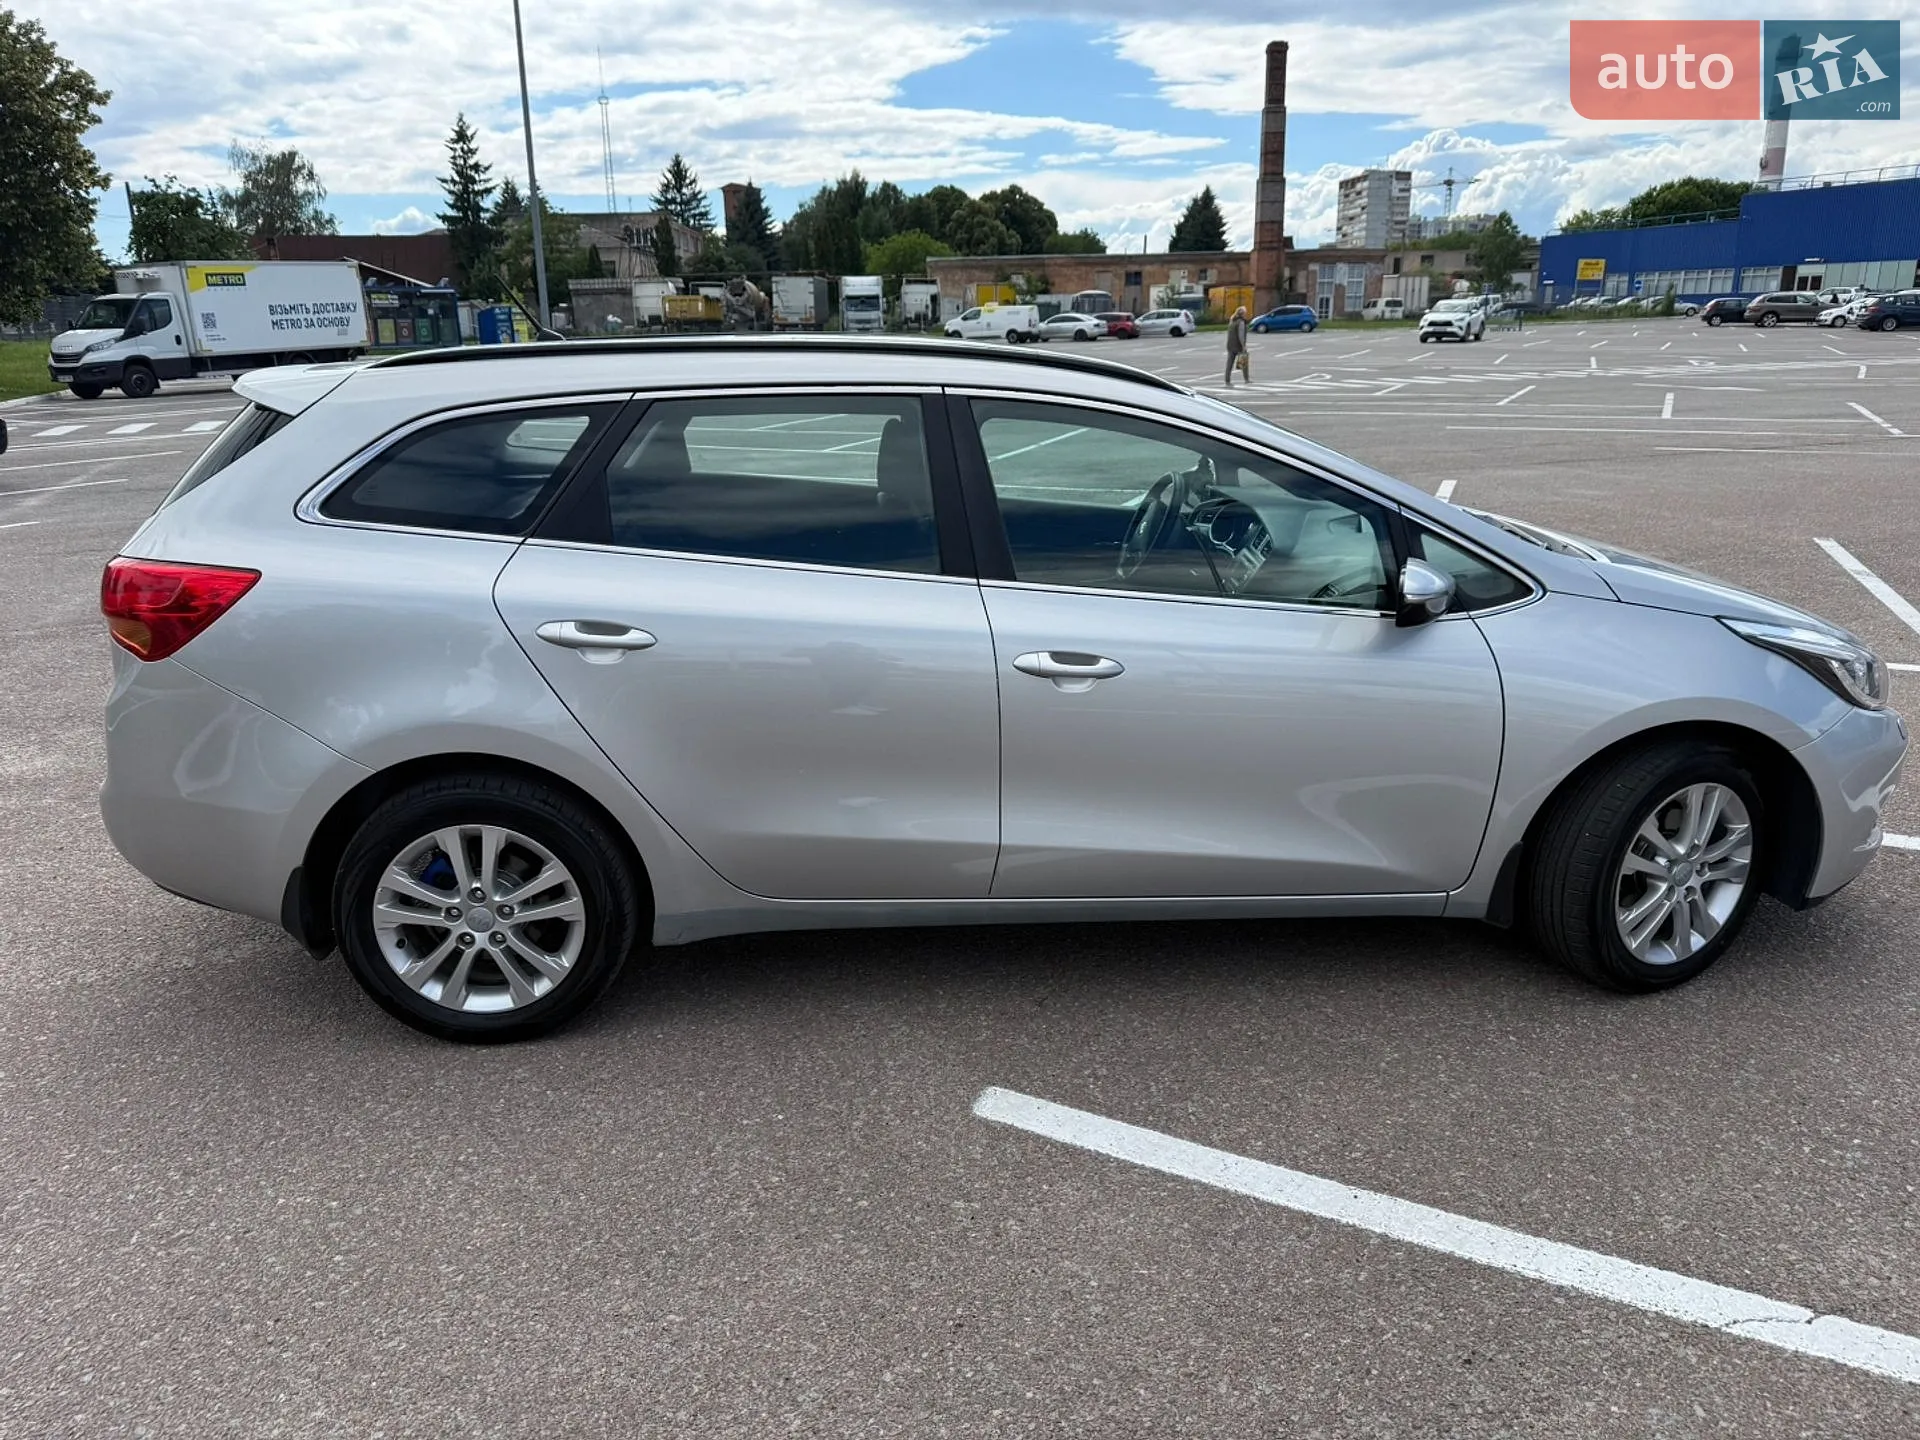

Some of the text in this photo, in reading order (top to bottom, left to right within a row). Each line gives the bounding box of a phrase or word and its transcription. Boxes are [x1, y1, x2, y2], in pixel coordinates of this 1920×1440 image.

[207, 274, 245, 285] METRO
[268, 302, 357, 316] ВІЗЬМІТЬ ДОСТАВКУ
[271, 316, 351, 331] METRO ЗА ОСНОВУ
